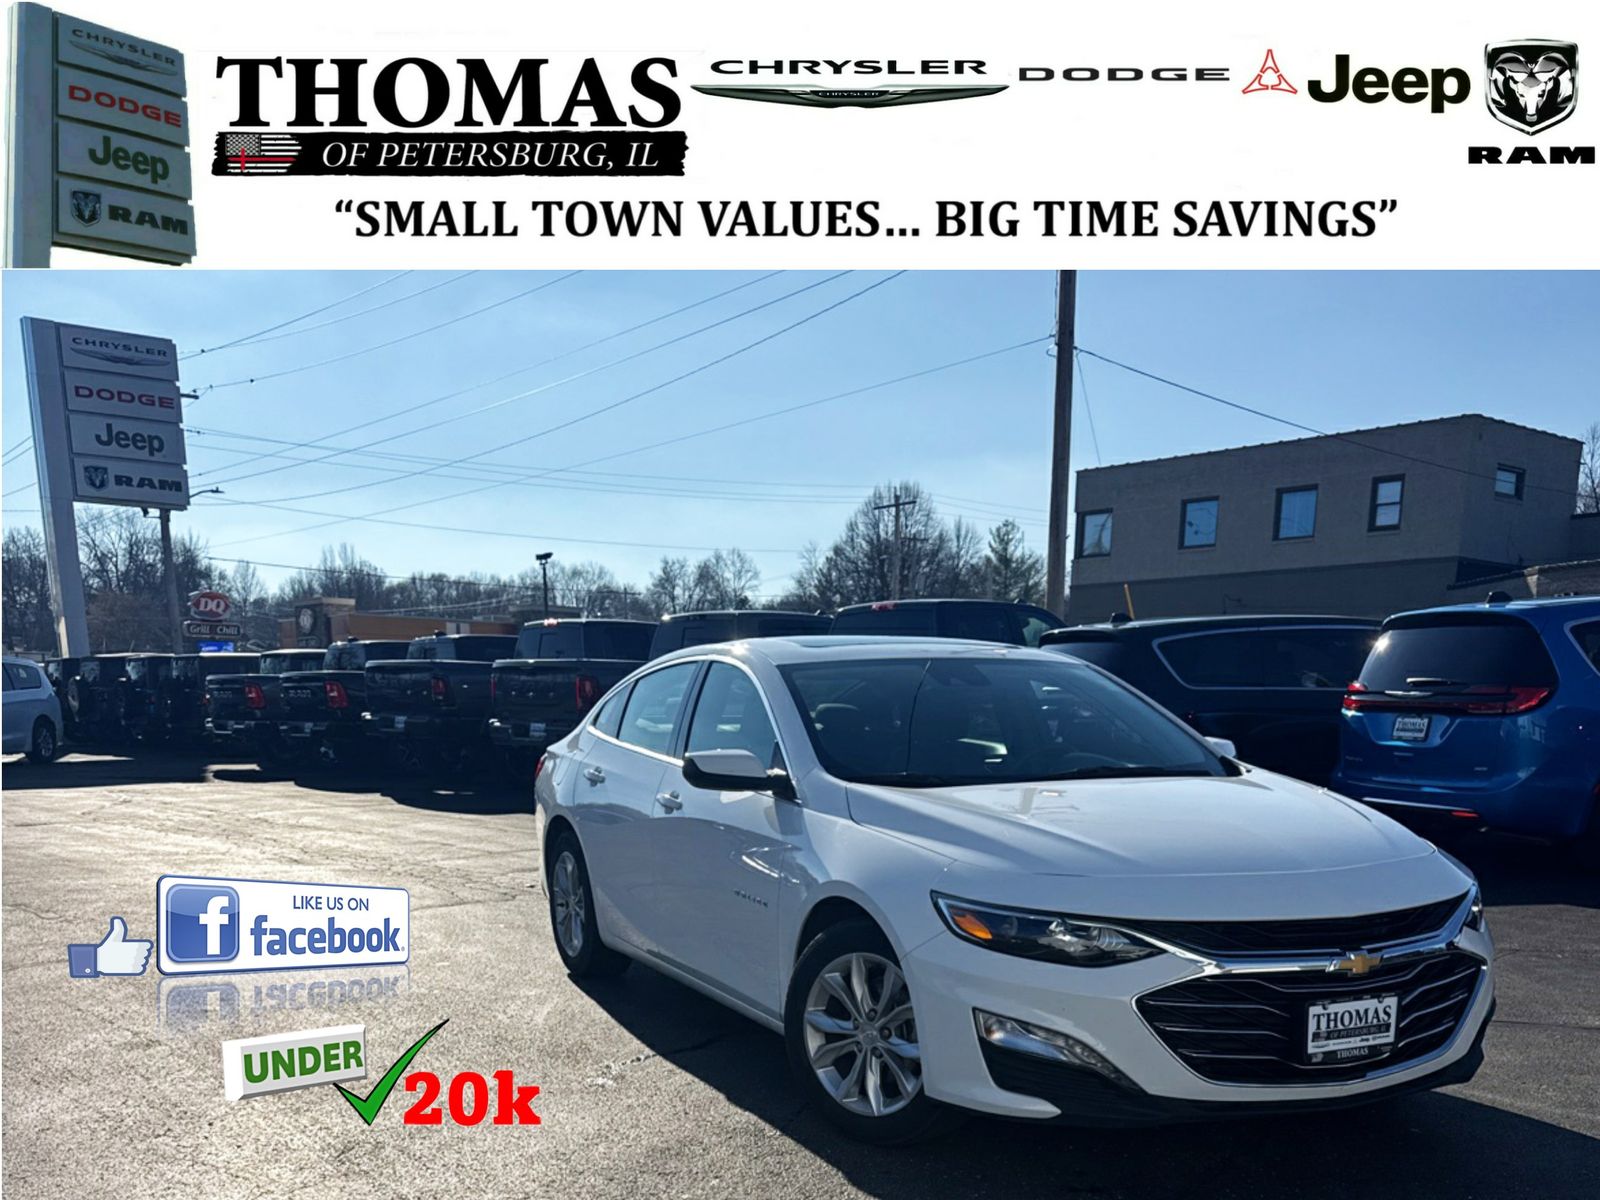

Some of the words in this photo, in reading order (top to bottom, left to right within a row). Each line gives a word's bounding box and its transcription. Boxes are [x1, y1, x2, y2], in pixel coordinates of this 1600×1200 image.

[72, 337, 168, 358] CHRYSLER
[74, 385, 175, 410] DODGE
[95, 423, 165, 456] Jeep
[114, 474, 183, 492] RAM
[200, 597, 226, 614] DQ
[190, 624, 210, 634] Grill
[216, 624, 239, 635] Chill
[1312, 1005, 1392, 1031] THOMAS
[1336, 1047, 1368, 1059] THOMAS
